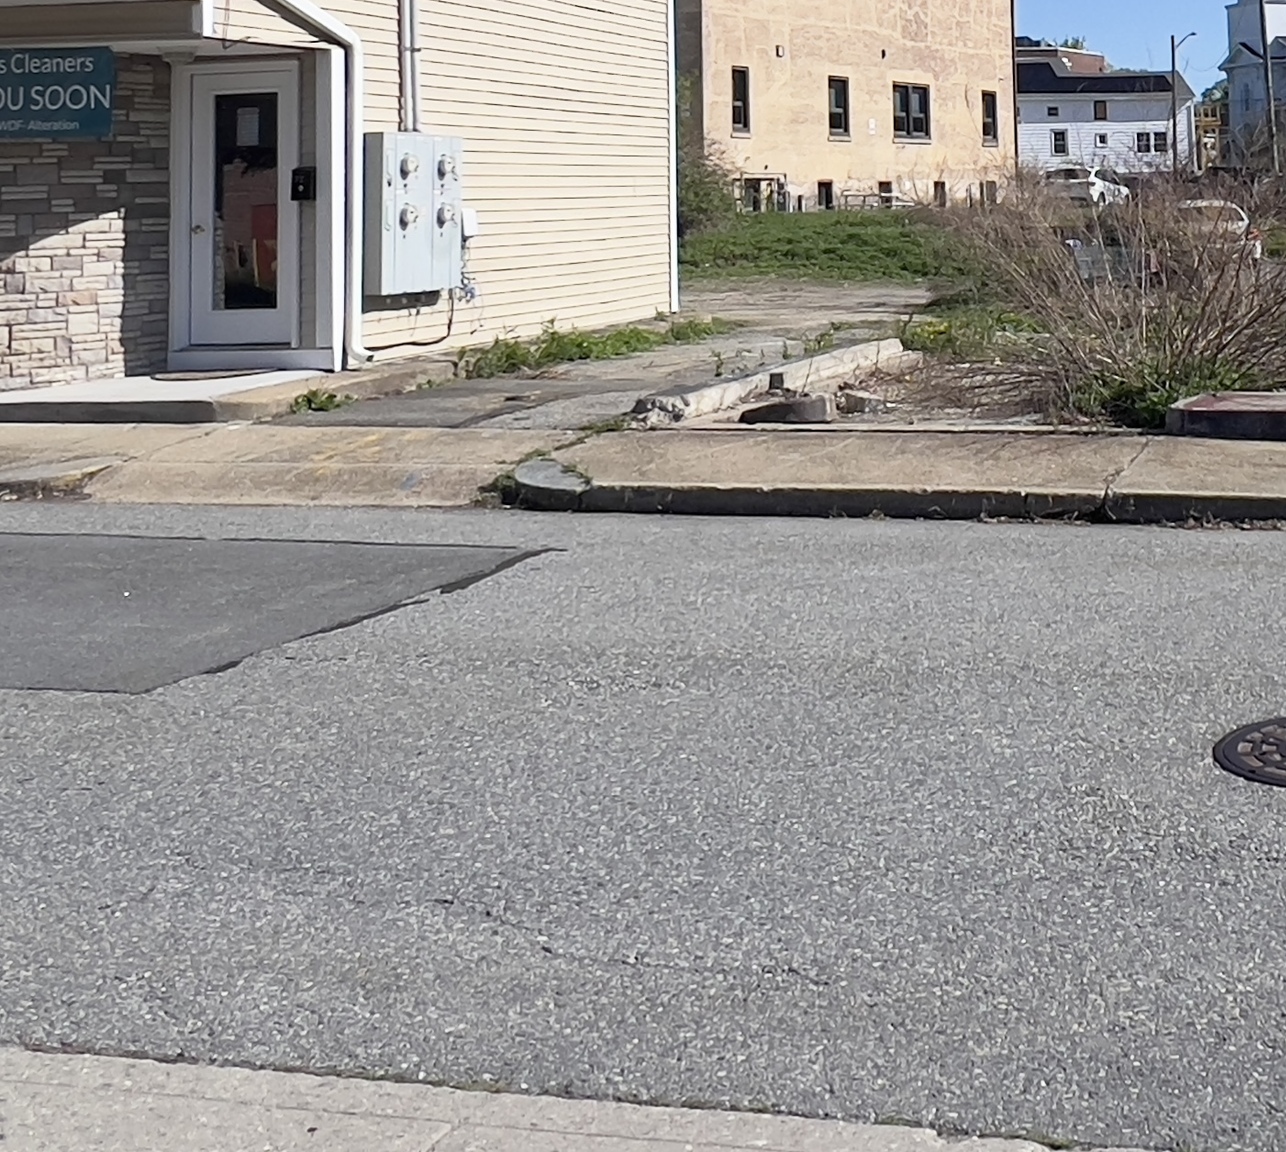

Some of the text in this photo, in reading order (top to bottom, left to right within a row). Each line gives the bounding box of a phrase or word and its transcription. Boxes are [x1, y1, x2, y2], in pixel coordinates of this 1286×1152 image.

[10, 53, 95, 74] Cleaners
[0, 84, 111, 111] U SOON
